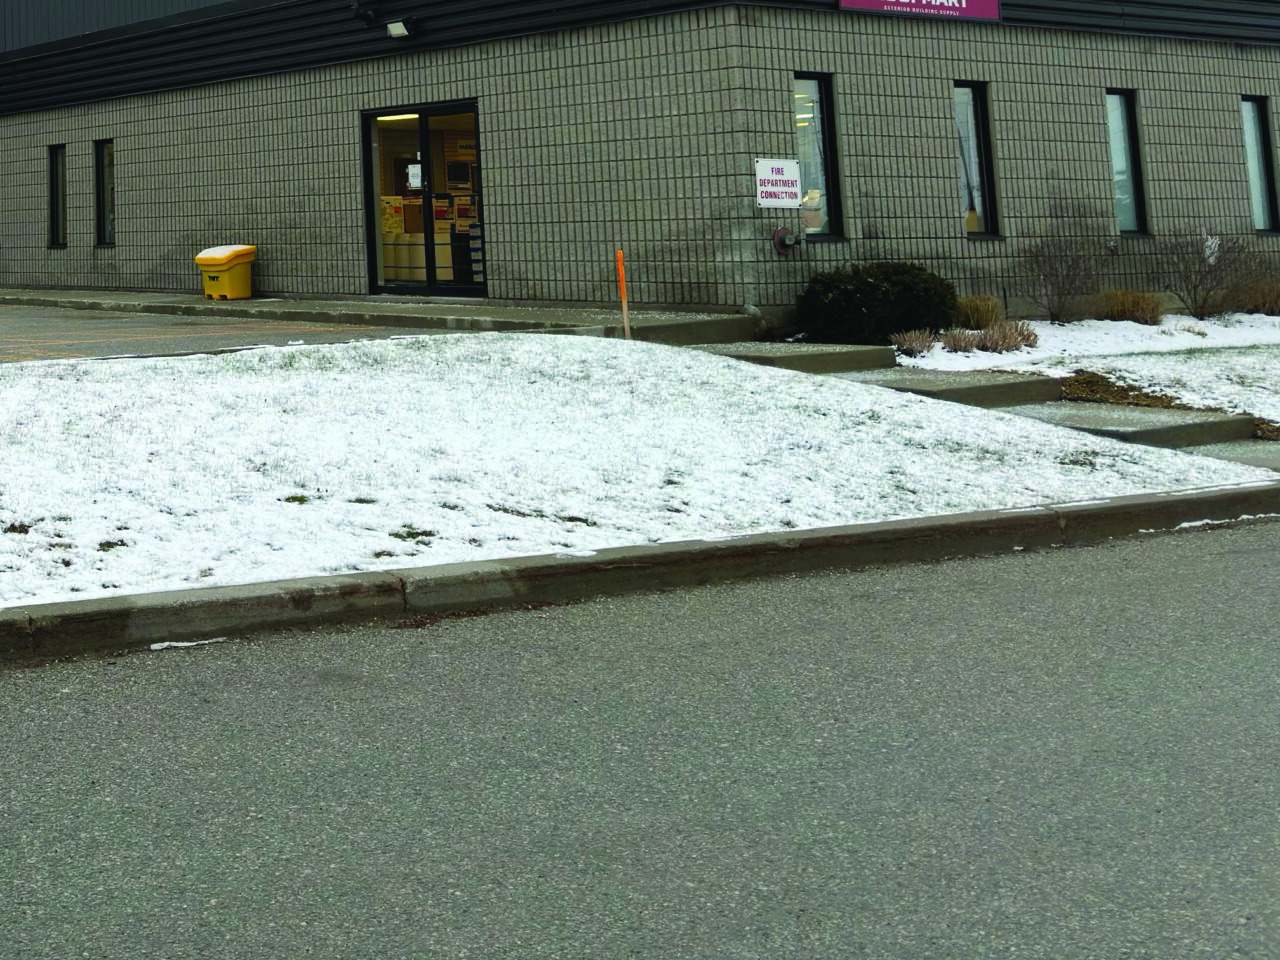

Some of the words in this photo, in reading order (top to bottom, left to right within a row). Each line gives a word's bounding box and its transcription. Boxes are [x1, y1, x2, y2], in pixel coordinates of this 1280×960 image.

[912, 7, 938, 15] BUILDING
[759, 179, 798, 187] DEPARTMENT
[760, 191, 798, 199] CONNECTION
